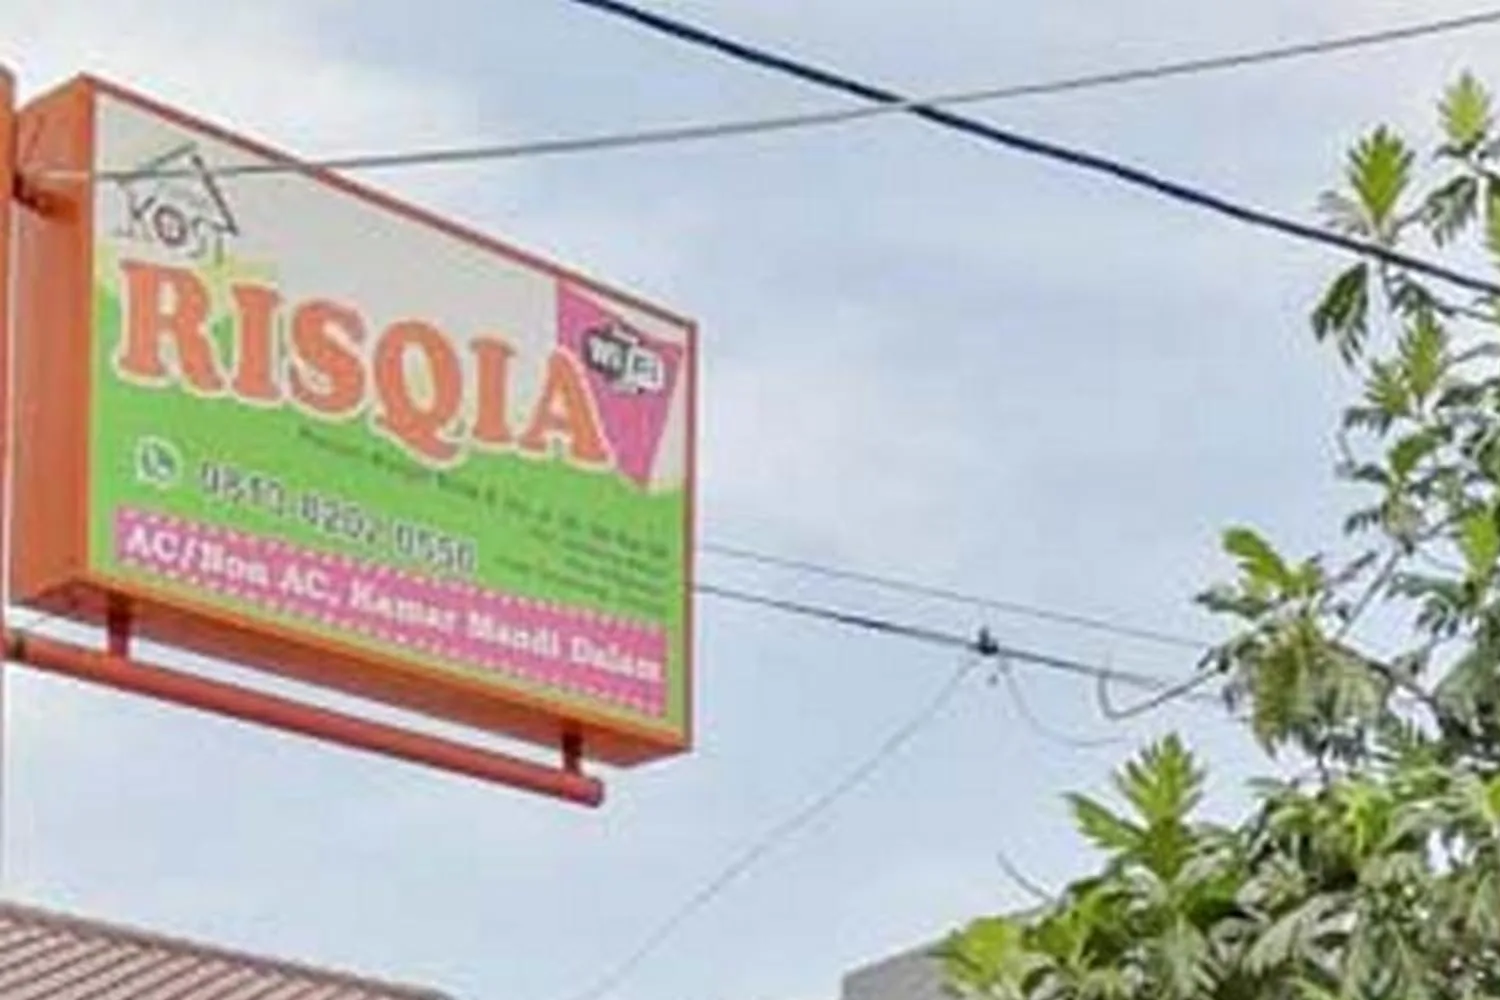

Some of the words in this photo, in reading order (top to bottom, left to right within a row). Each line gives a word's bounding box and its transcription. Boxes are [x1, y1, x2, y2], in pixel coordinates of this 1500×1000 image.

[116, 258, 616, 466] RISQIA
[350, 577, 455, 634] Kamar
[467, 608, 561, 659] Mandi
[570, 633, 662, 683] Dalam
